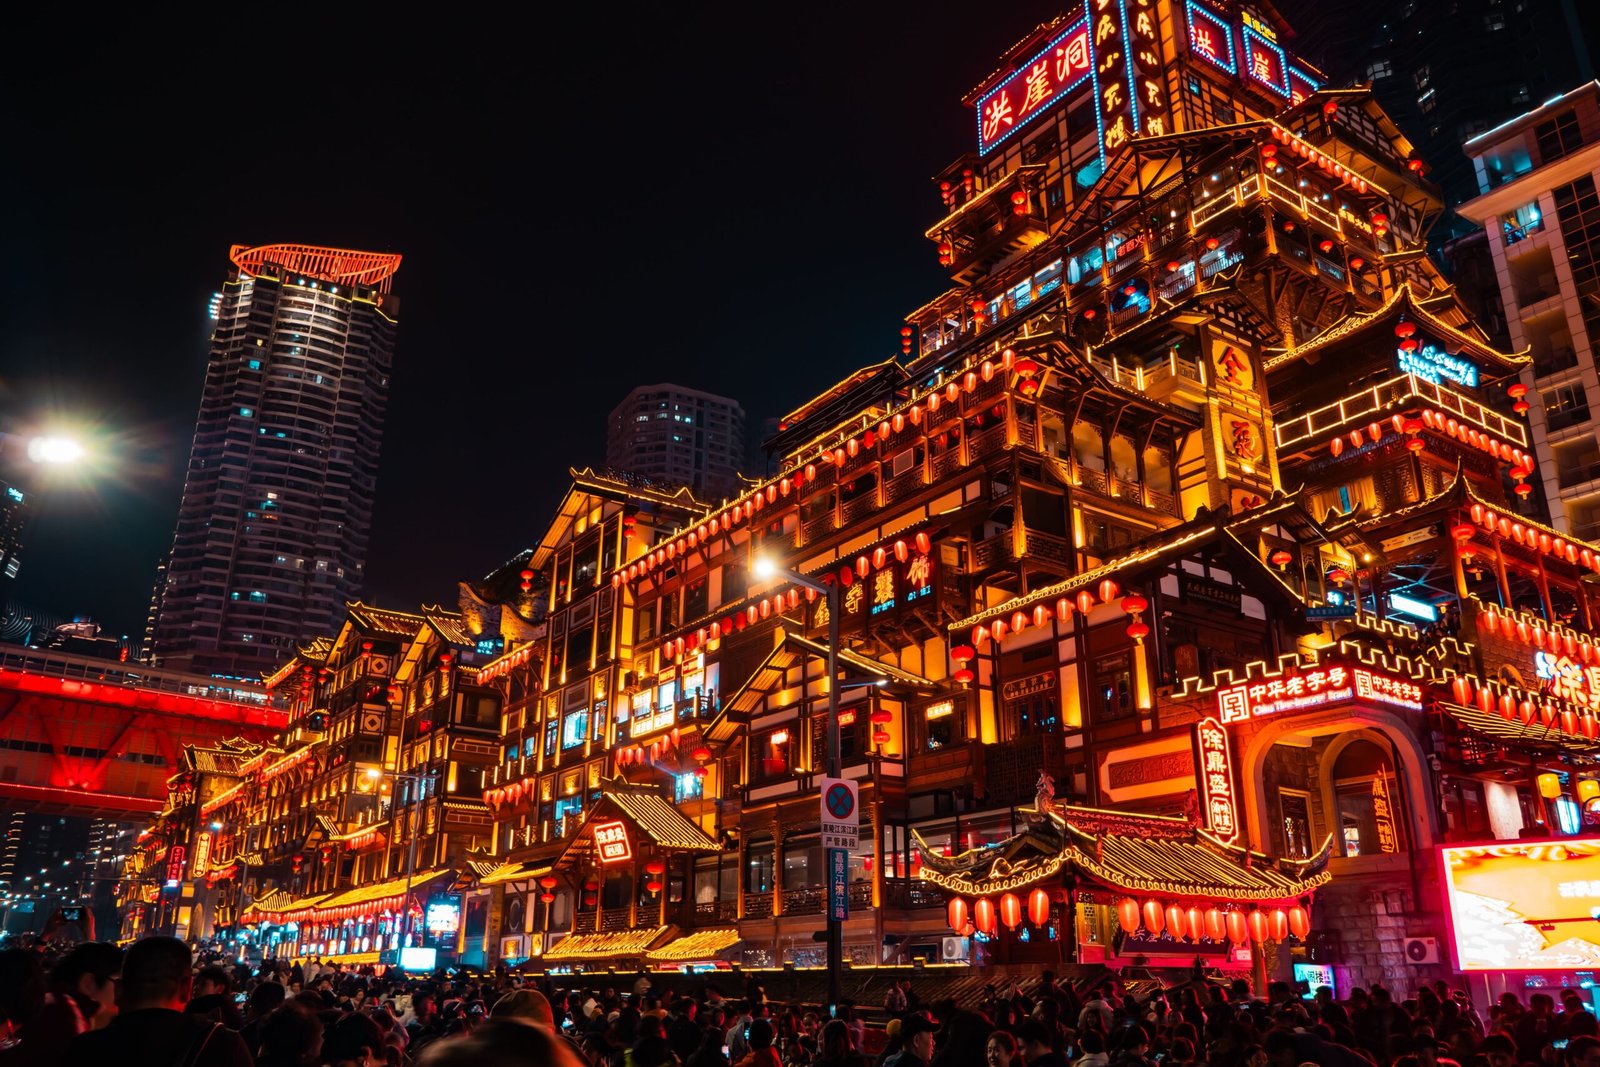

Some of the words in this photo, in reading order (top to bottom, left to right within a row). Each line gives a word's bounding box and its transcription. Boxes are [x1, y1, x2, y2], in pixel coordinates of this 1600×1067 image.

[982, 32, 1090, 140] 洪崖洞
[1250, 666, 1348, 702] 中华老字号
[1372, 675, 1422, 701] 中华老字号
[1202, 728, 1230, 797] 徐鼎盛
[822, 823, 858, 836] 嘉陵江滨江路
[825, 836, 856, 848] 严管路段
[835, 851, 845, 919] 嘉陵江滨江路
